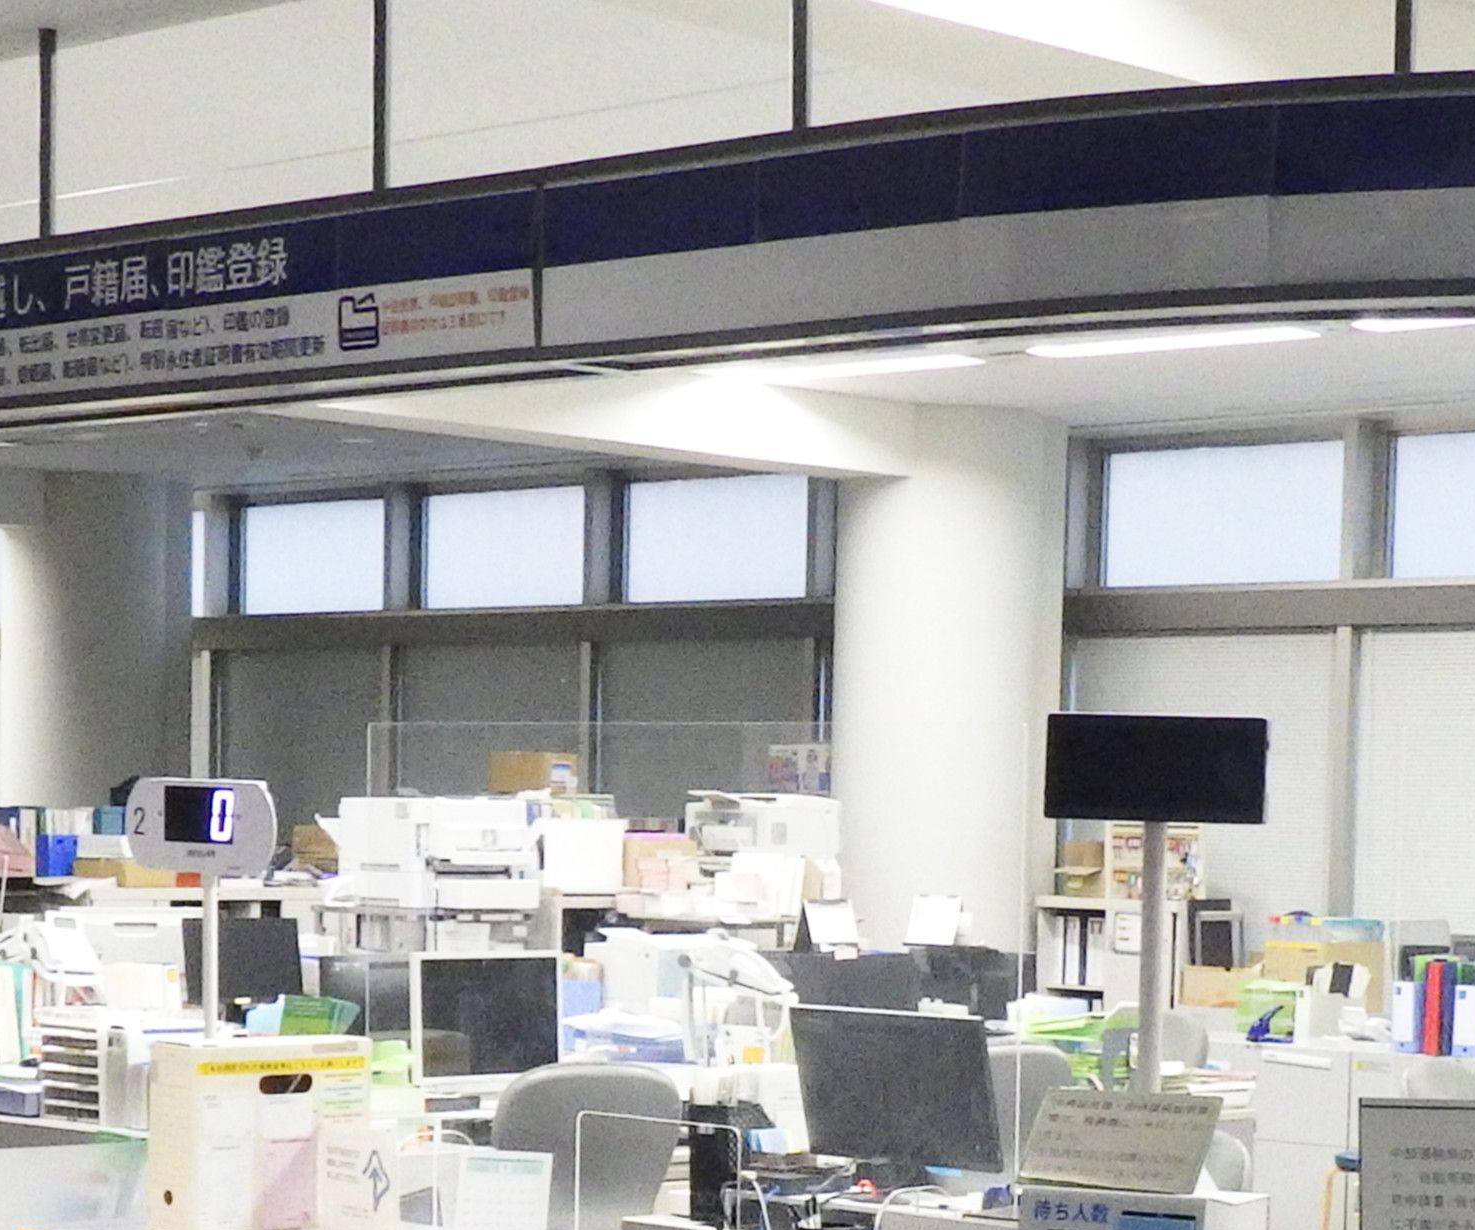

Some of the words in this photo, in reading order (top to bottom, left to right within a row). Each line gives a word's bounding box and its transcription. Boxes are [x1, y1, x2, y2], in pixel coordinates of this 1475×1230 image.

[133, 807, 146, 835] 2
[210, 789, 235, 842] 0
[1033, 1200, 1109, 1224] 待ち人数
